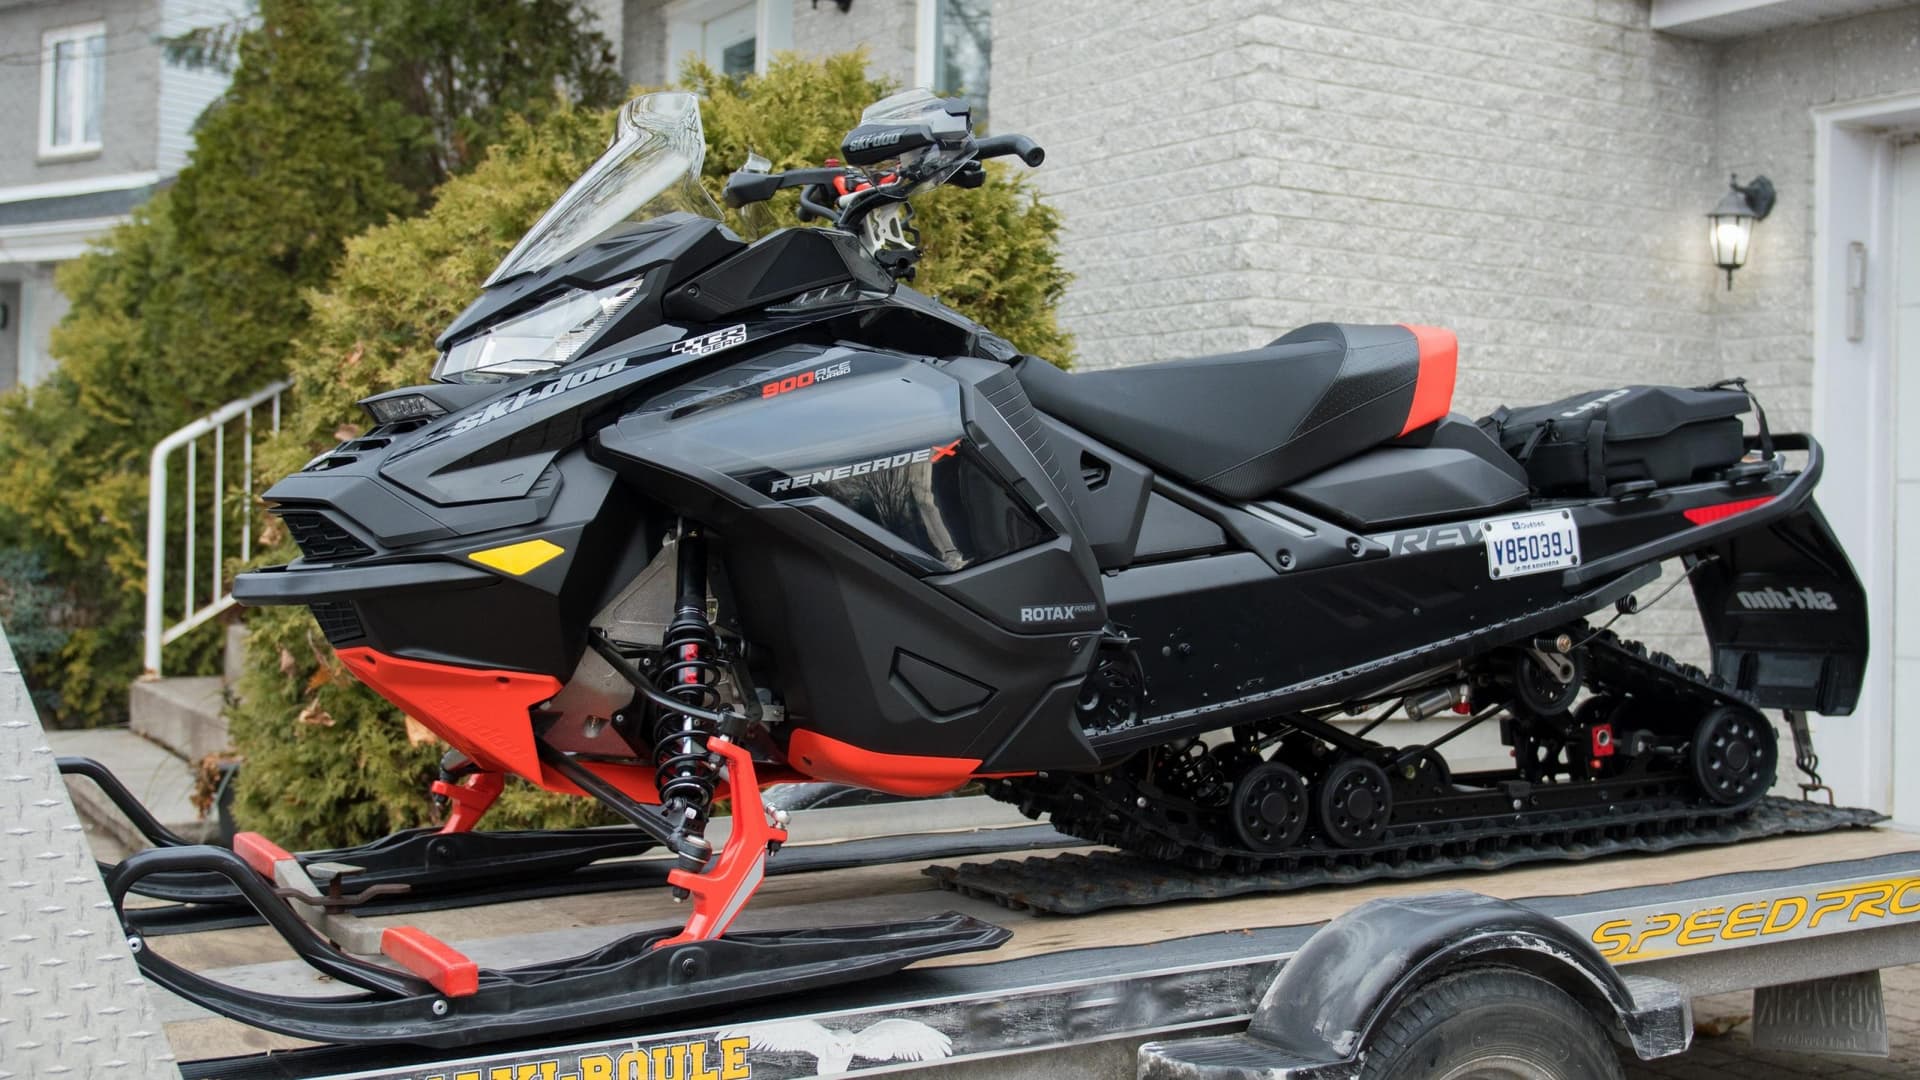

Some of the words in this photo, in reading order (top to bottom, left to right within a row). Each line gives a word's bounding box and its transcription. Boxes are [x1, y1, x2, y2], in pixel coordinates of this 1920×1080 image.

[450, 357, 629, 437] ski-doo
[762, 371, 815, 399] 900
[815, 360, 851, 379] ACE
[1494, 530, 1573, 566] V85039J
[1021, 606, 1075, 622] ROTAX
